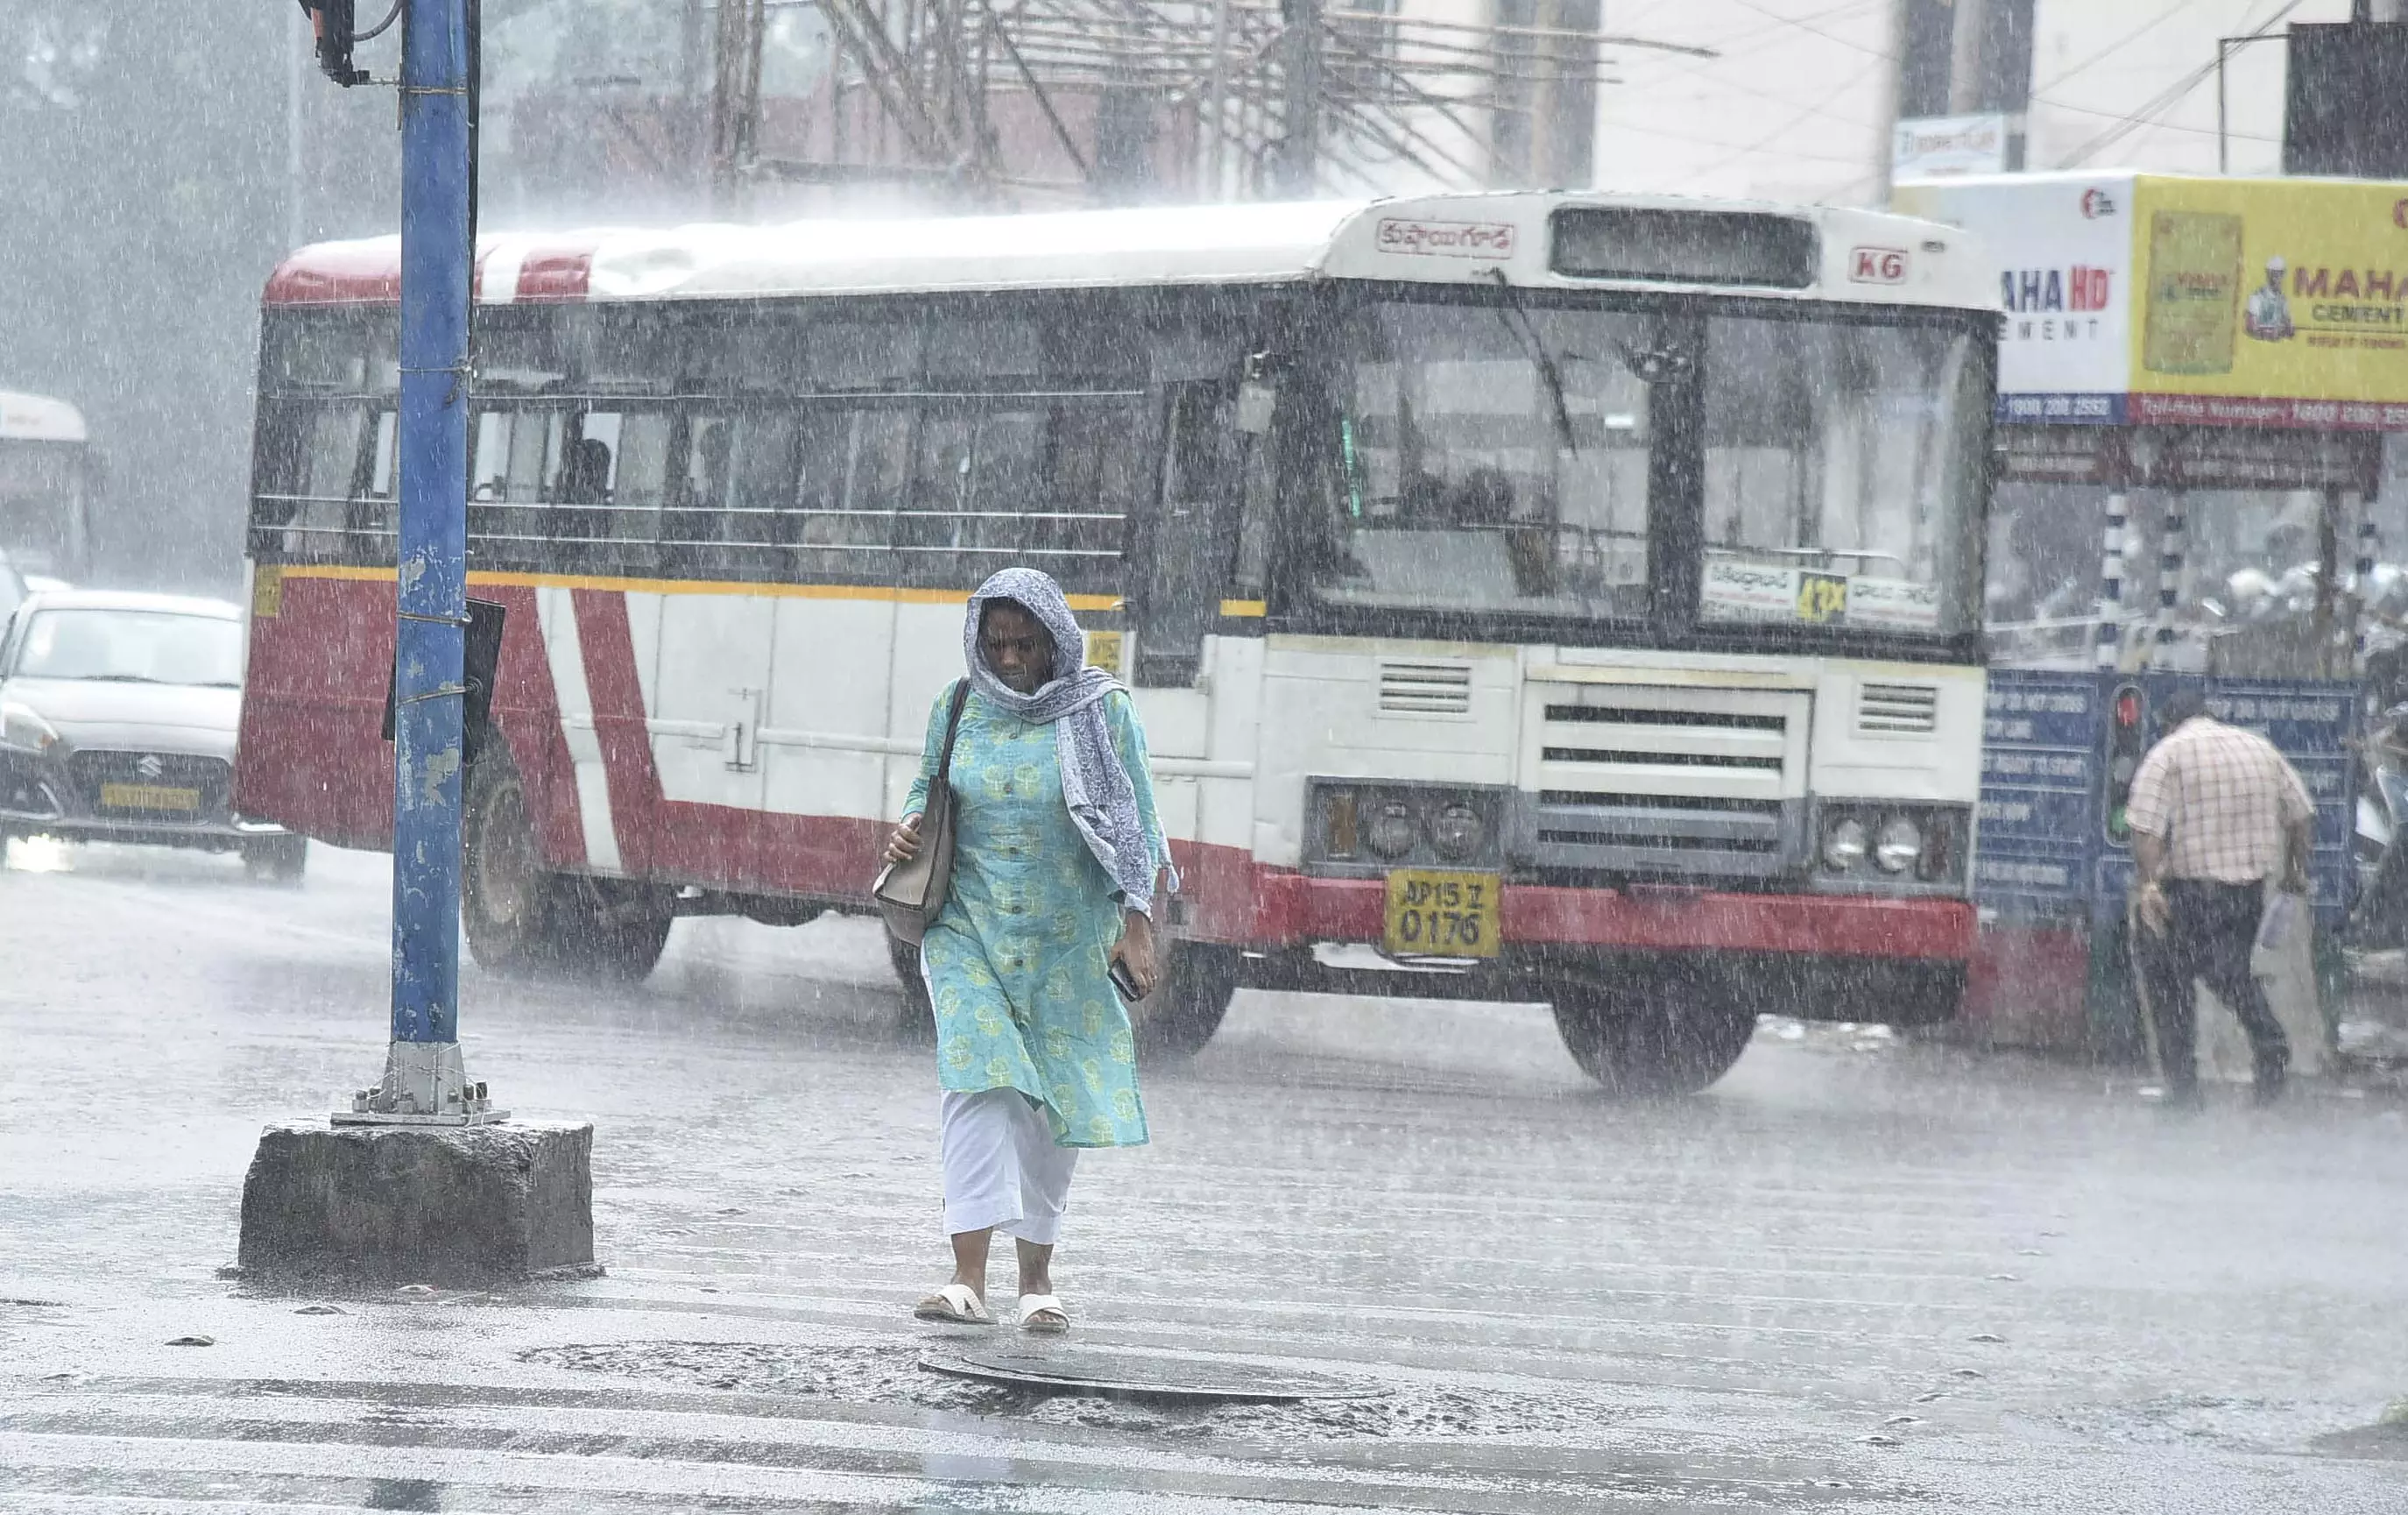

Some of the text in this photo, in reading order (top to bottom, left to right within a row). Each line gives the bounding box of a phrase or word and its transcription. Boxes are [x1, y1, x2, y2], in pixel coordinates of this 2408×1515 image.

[1856, 251, 1903, 279] KG
[2069, 265, 2108, 312] HD
[1403, 910, 1480, 945] 0176
